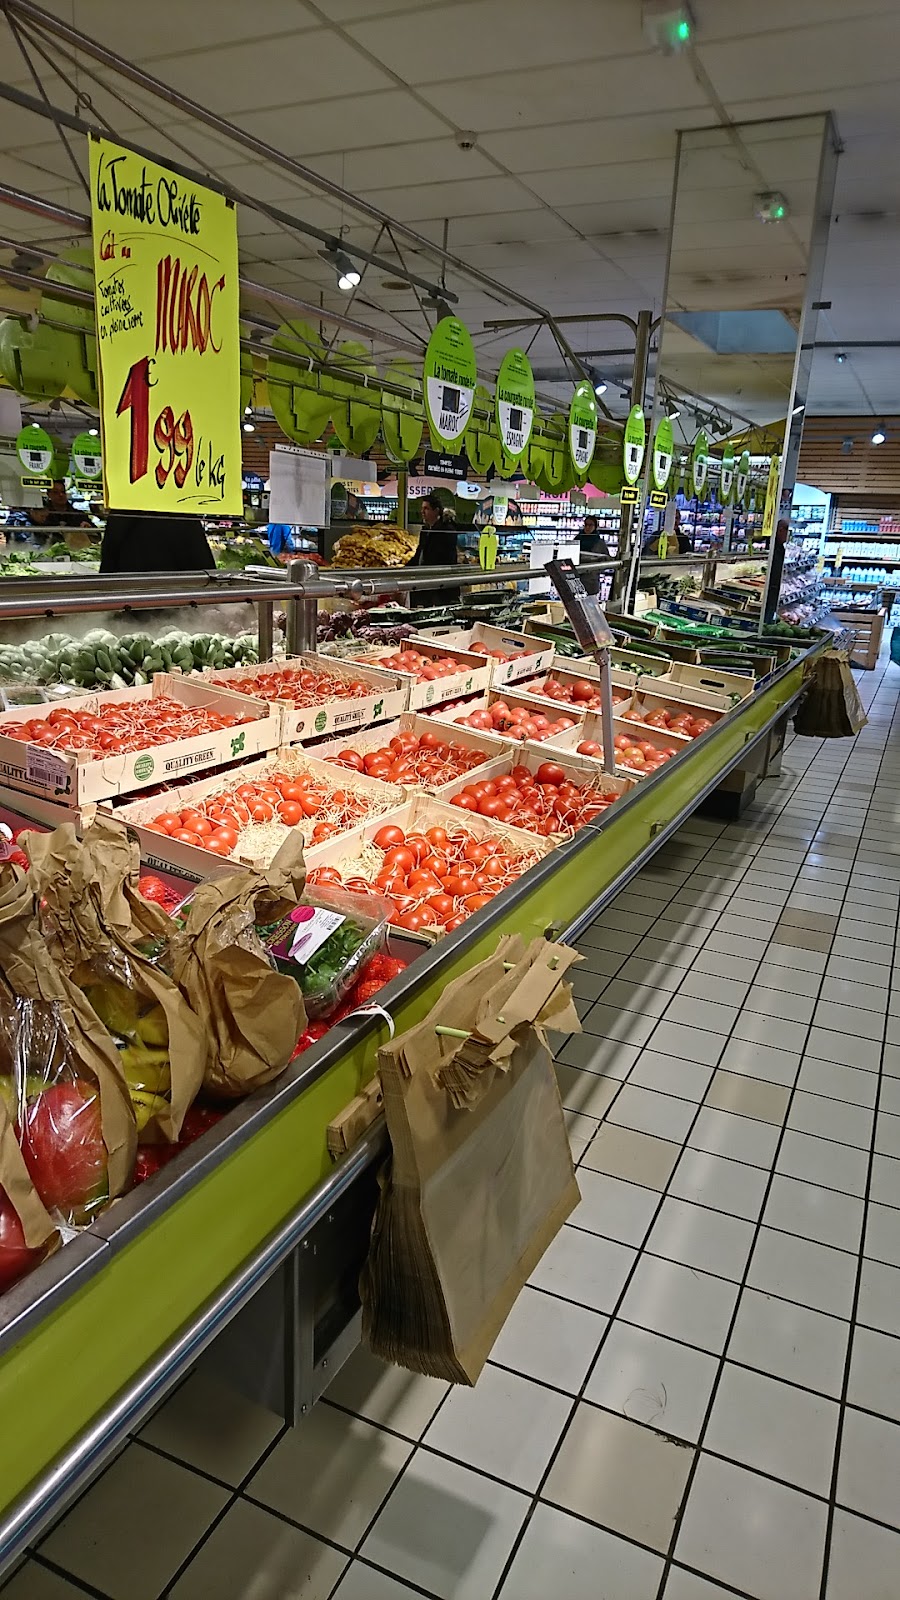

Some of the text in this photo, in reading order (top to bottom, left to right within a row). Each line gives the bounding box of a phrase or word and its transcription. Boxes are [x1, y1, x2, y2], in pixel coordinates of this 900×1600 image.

[105, 156, 156, 225] Tomate
[155, 254, 226, 356] MAROC
[439, 412, 460, 432] MAROC
[506, 430, 525, 448] ESPAGNE
[29, 461, 44, 470] FRANCE
[165, 750, 214, 771] QUALITY GREEN
[265, 918, 294, 946] CRESSON
